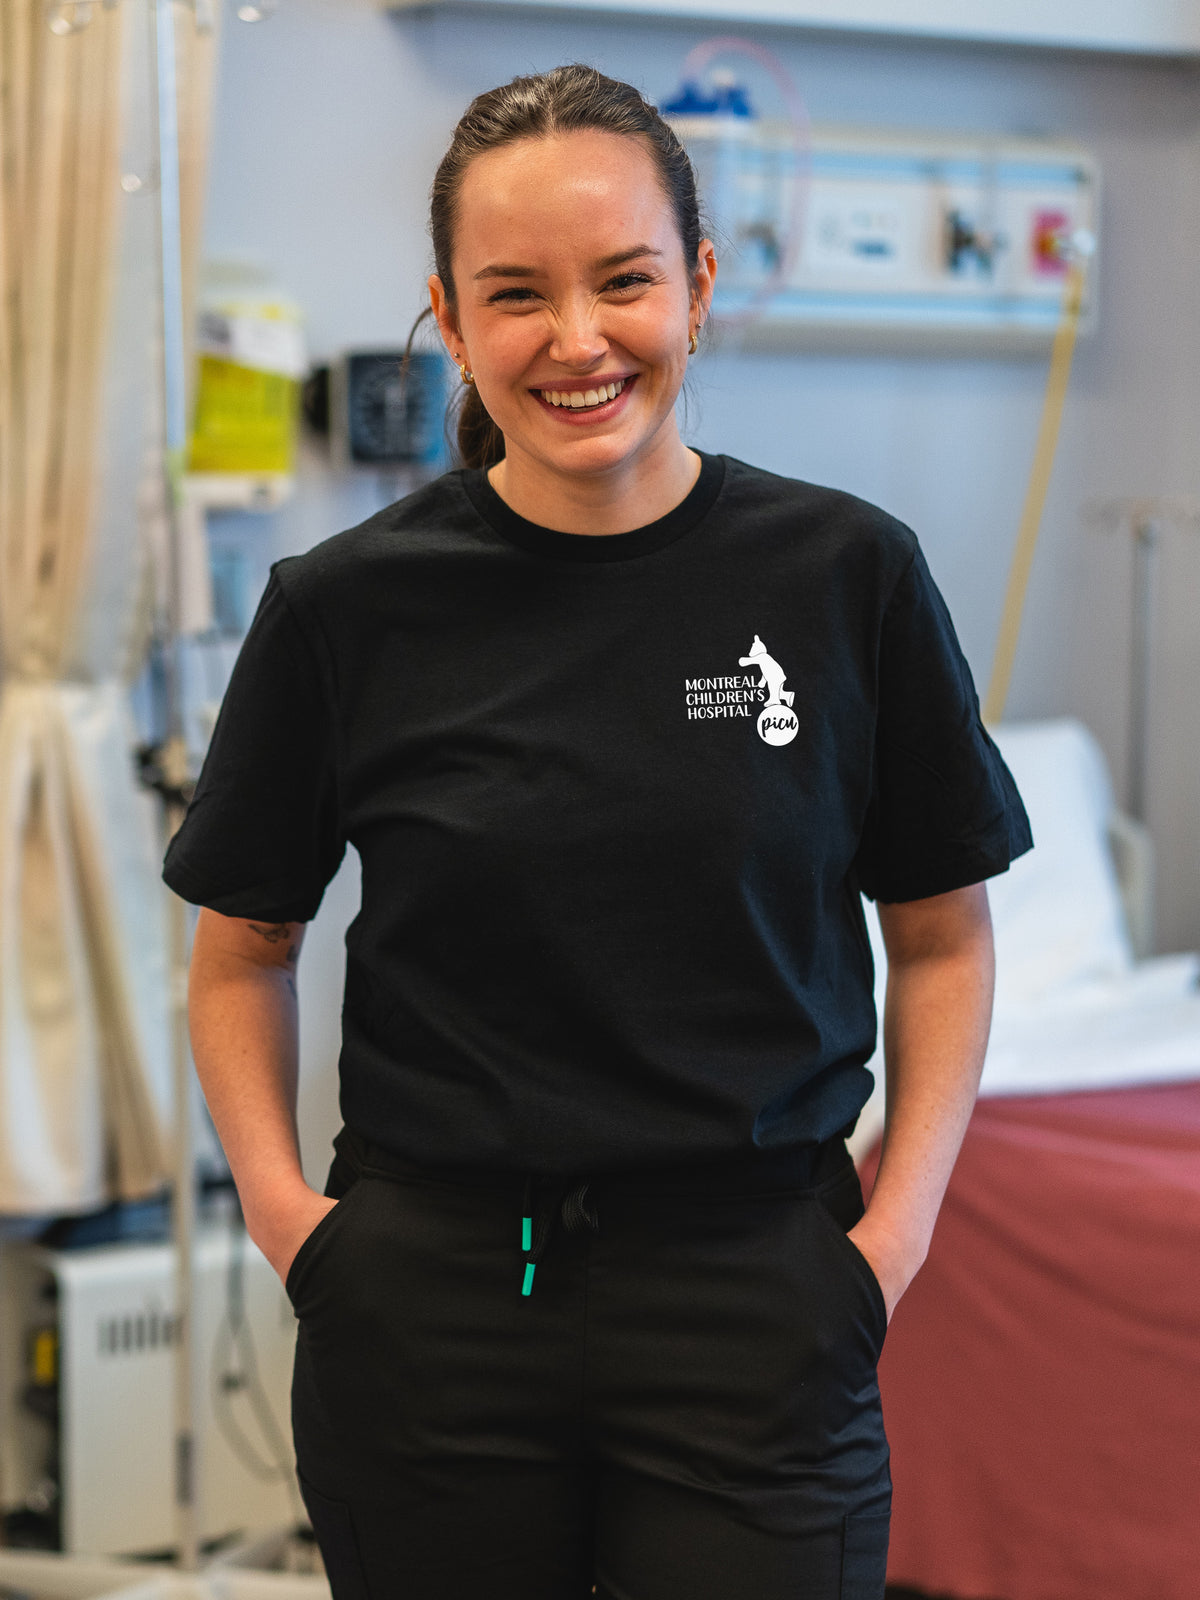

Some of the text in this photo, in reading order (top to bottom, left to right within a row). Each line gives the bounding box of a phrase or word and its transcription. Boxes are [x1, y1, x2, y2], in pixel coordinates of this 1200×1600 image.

[685, 675, 758, 691] MONTREAL
[685, 689, 765, 706] CHILDREN'S
[687, 705, 752, 720] HOSPITAL
[761, 716, 798, 738] picu
